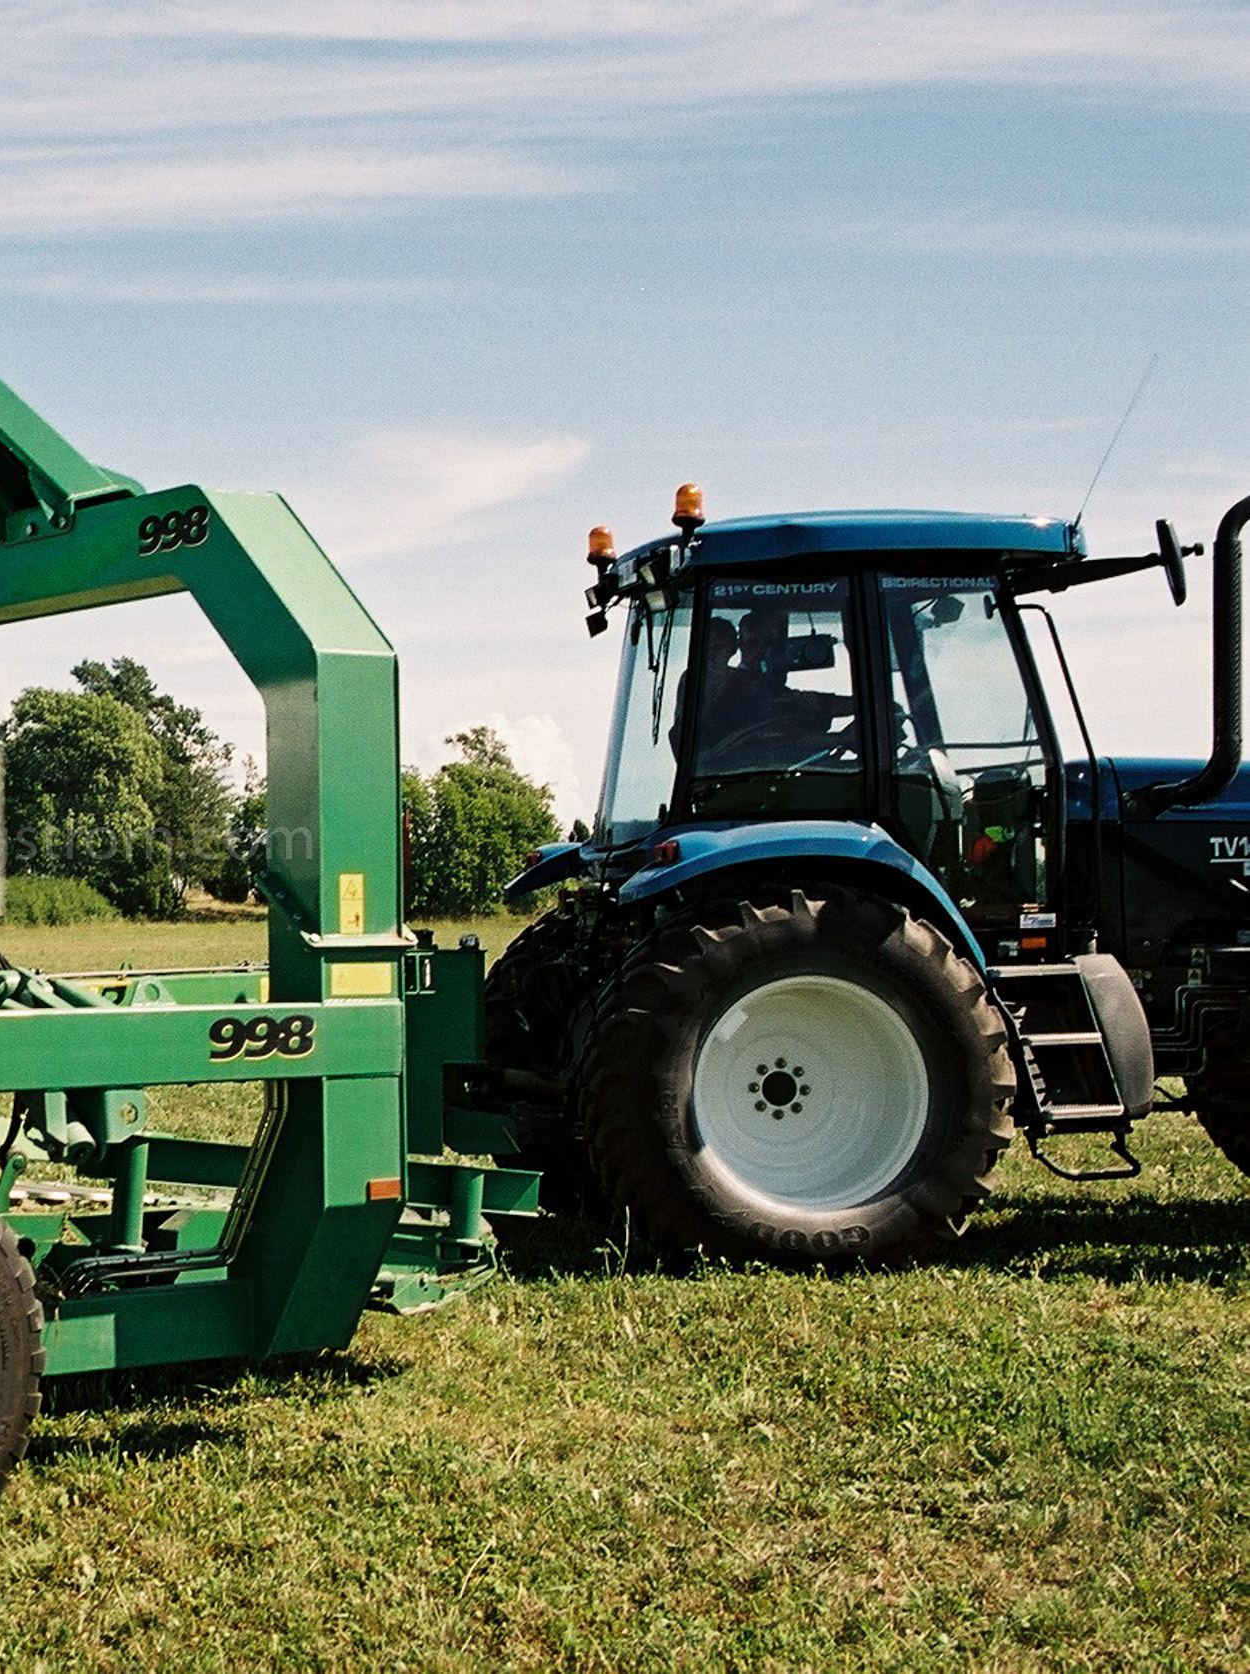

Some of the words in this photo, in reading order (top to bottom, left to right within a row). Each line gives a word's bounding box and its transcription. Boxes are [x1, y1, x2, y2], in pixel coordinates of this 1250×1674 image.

[138, 505, 210, 557] 998
[752, 583, 837, 595] CENTURY
[882, 577, 996, 588] BIDIRECTIONAL
[1210, 836, 1250, 857] TV1
[209, 1015, 316, 1062] 998
